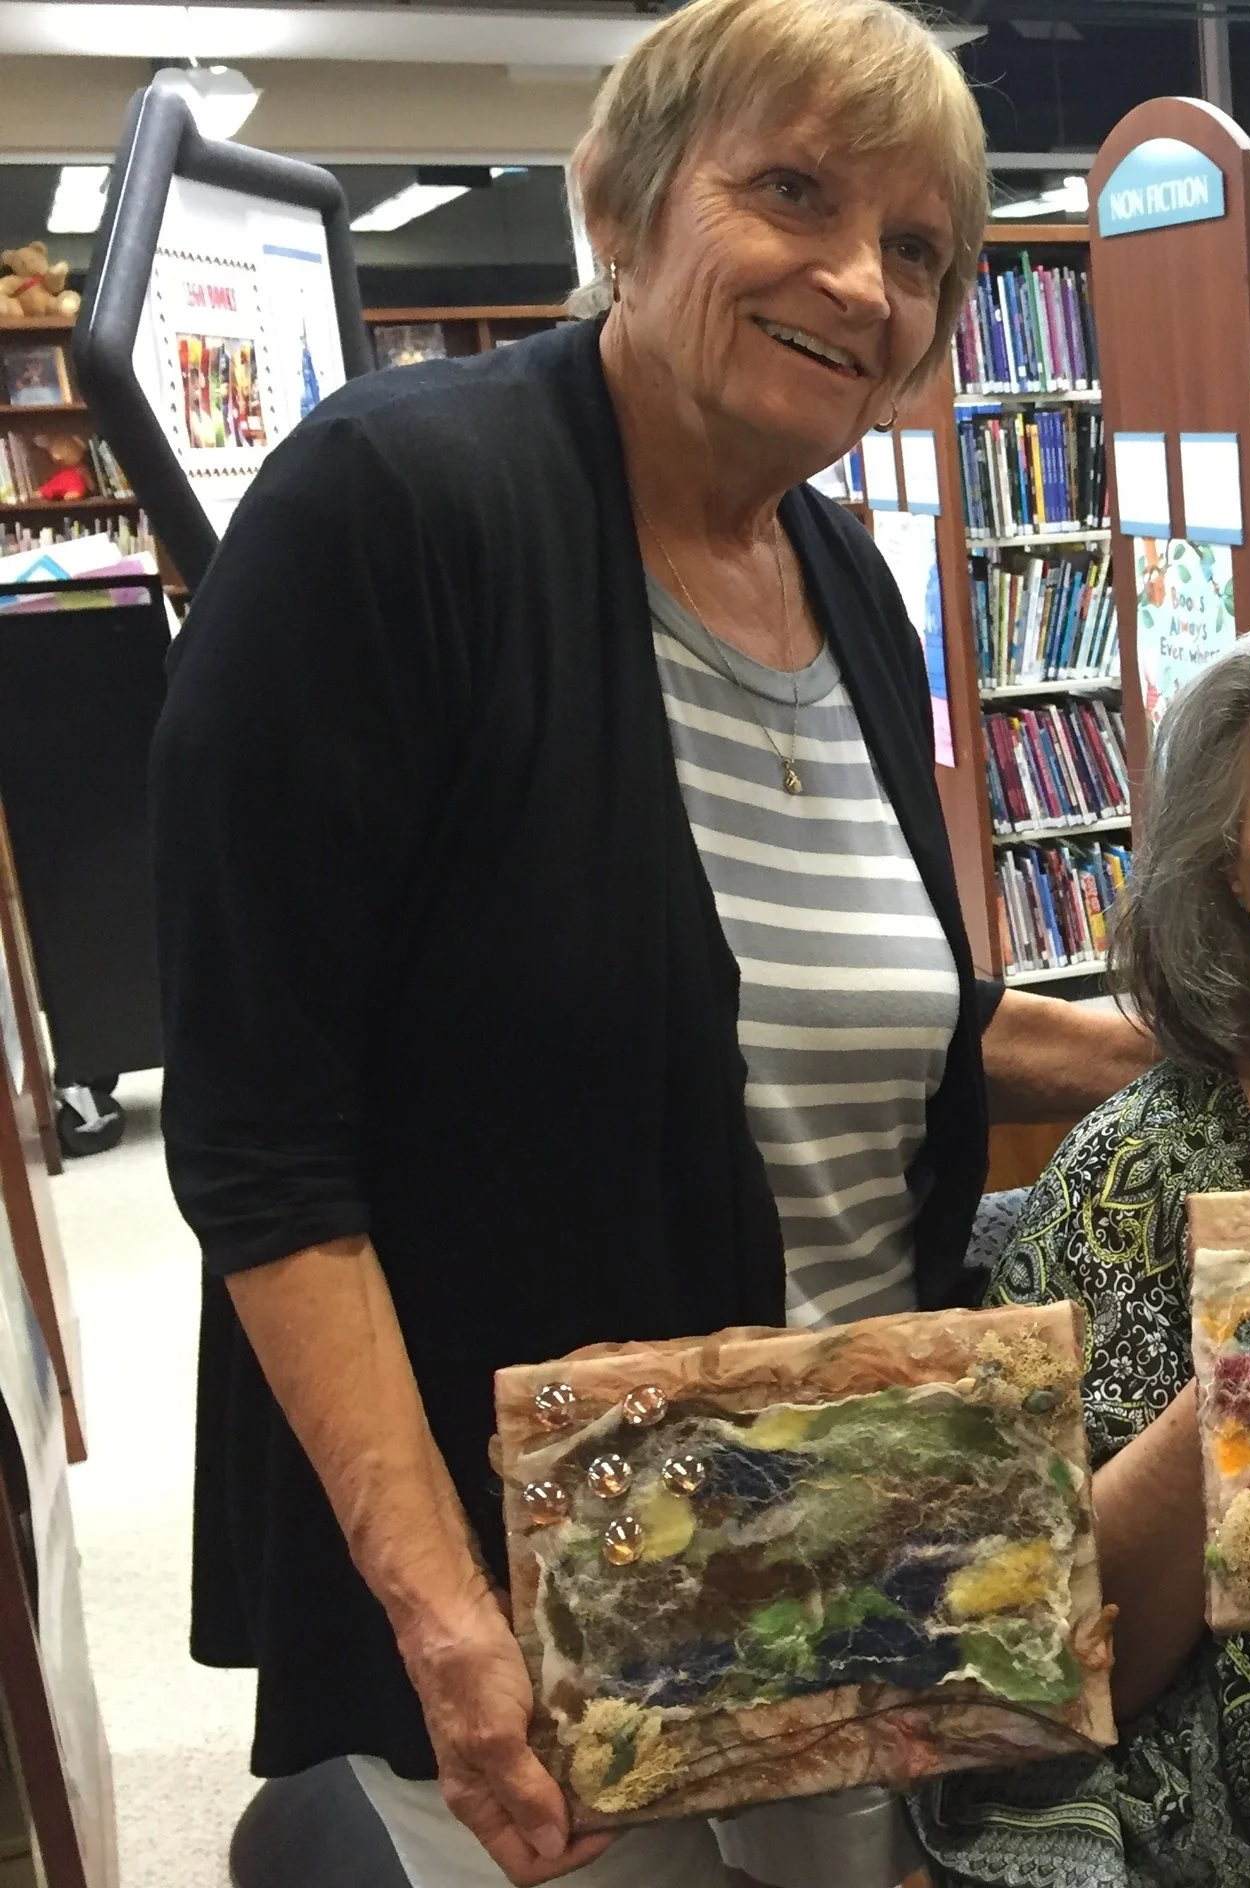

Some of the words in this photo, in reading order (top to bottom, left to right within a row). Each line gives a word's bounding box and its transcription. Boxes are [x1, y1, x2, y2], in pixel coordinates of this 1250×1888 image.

[1110, 189, 1145, 221] NON
[1146, 174, 1209, 215] FICTION
[1170, 586, 1205, 614] Boos
[1169, 615, 1208, 644] Always
